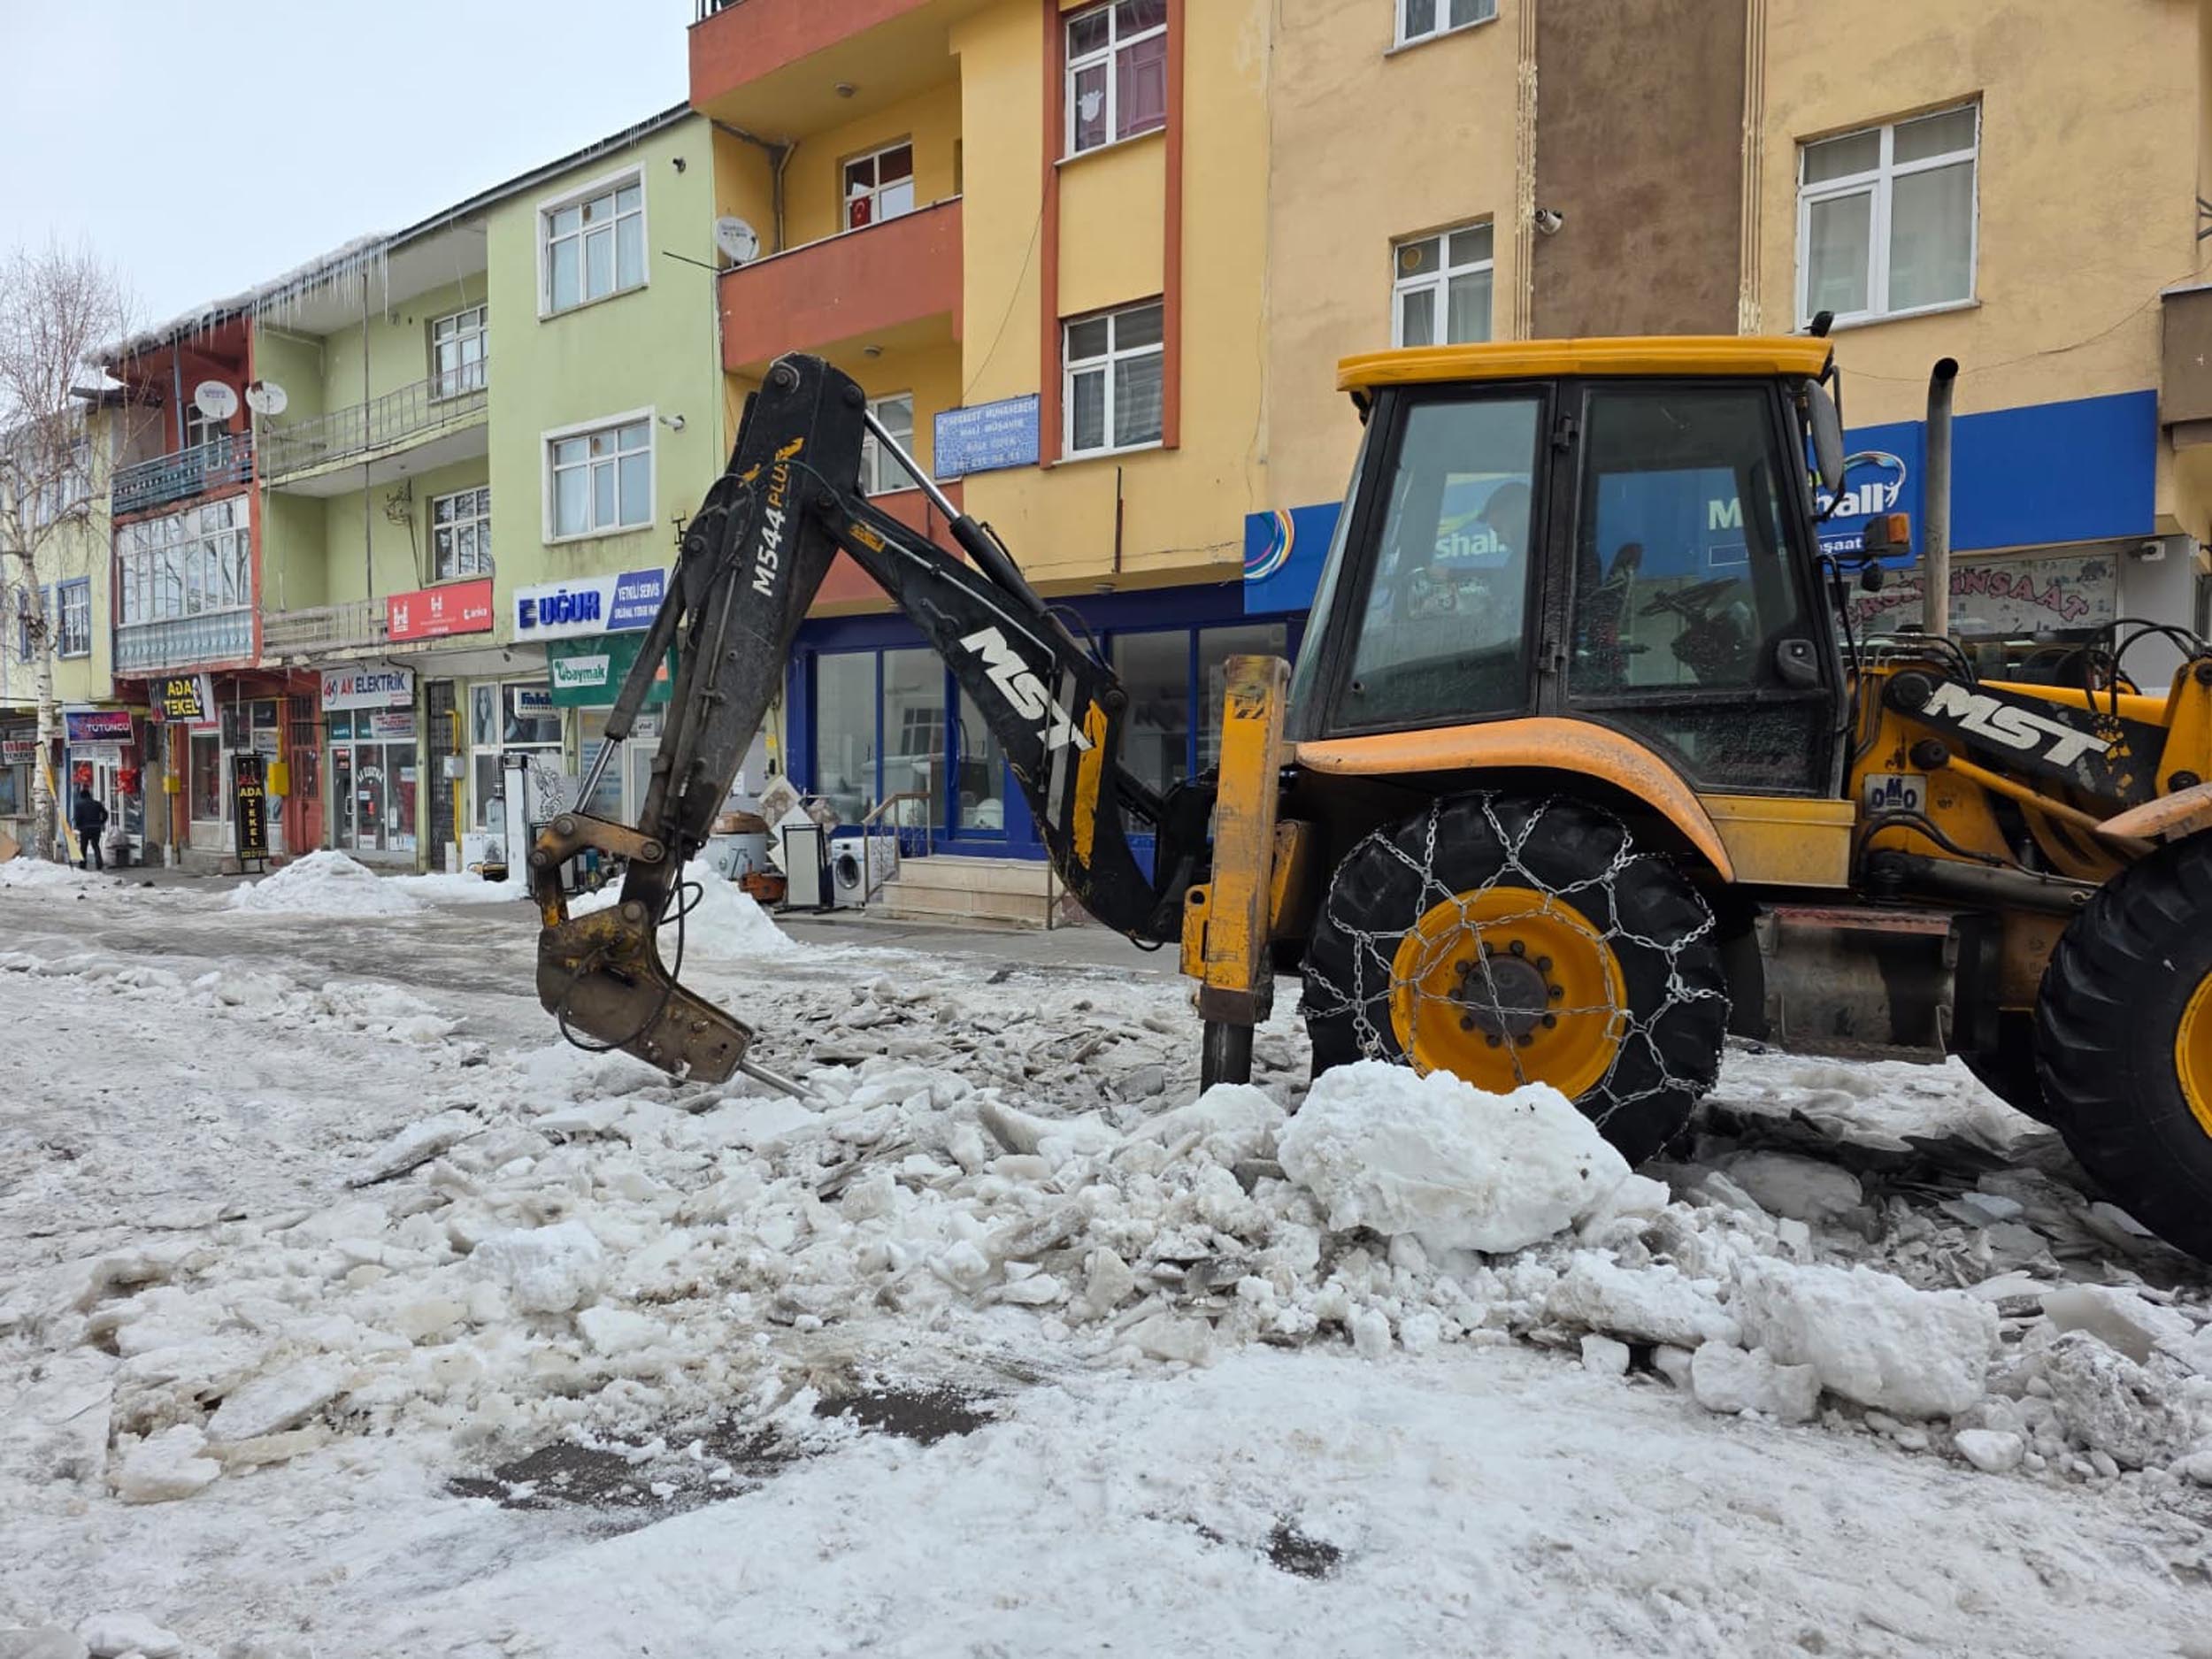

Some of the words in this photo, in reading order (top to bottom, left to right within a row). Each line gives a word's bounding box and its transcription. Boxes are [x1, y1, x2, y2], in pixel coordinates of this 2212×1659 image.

[753, 508, 786, 596] M544
[539, 588, 601, 625] UĞUR
[167, 680, 193, 695] ADA
[356, 672, 405, 694] ELEKTRİK
[565, 664, 604, 683] baymak
[959, 626, 1094, 751] MST
[164, 699, 200, 715] TEKEL
[1922, 682, 2111, 767] MST
[240, 787, 263, 797] ADA
[248, 798, 258, 847] TEKEL
